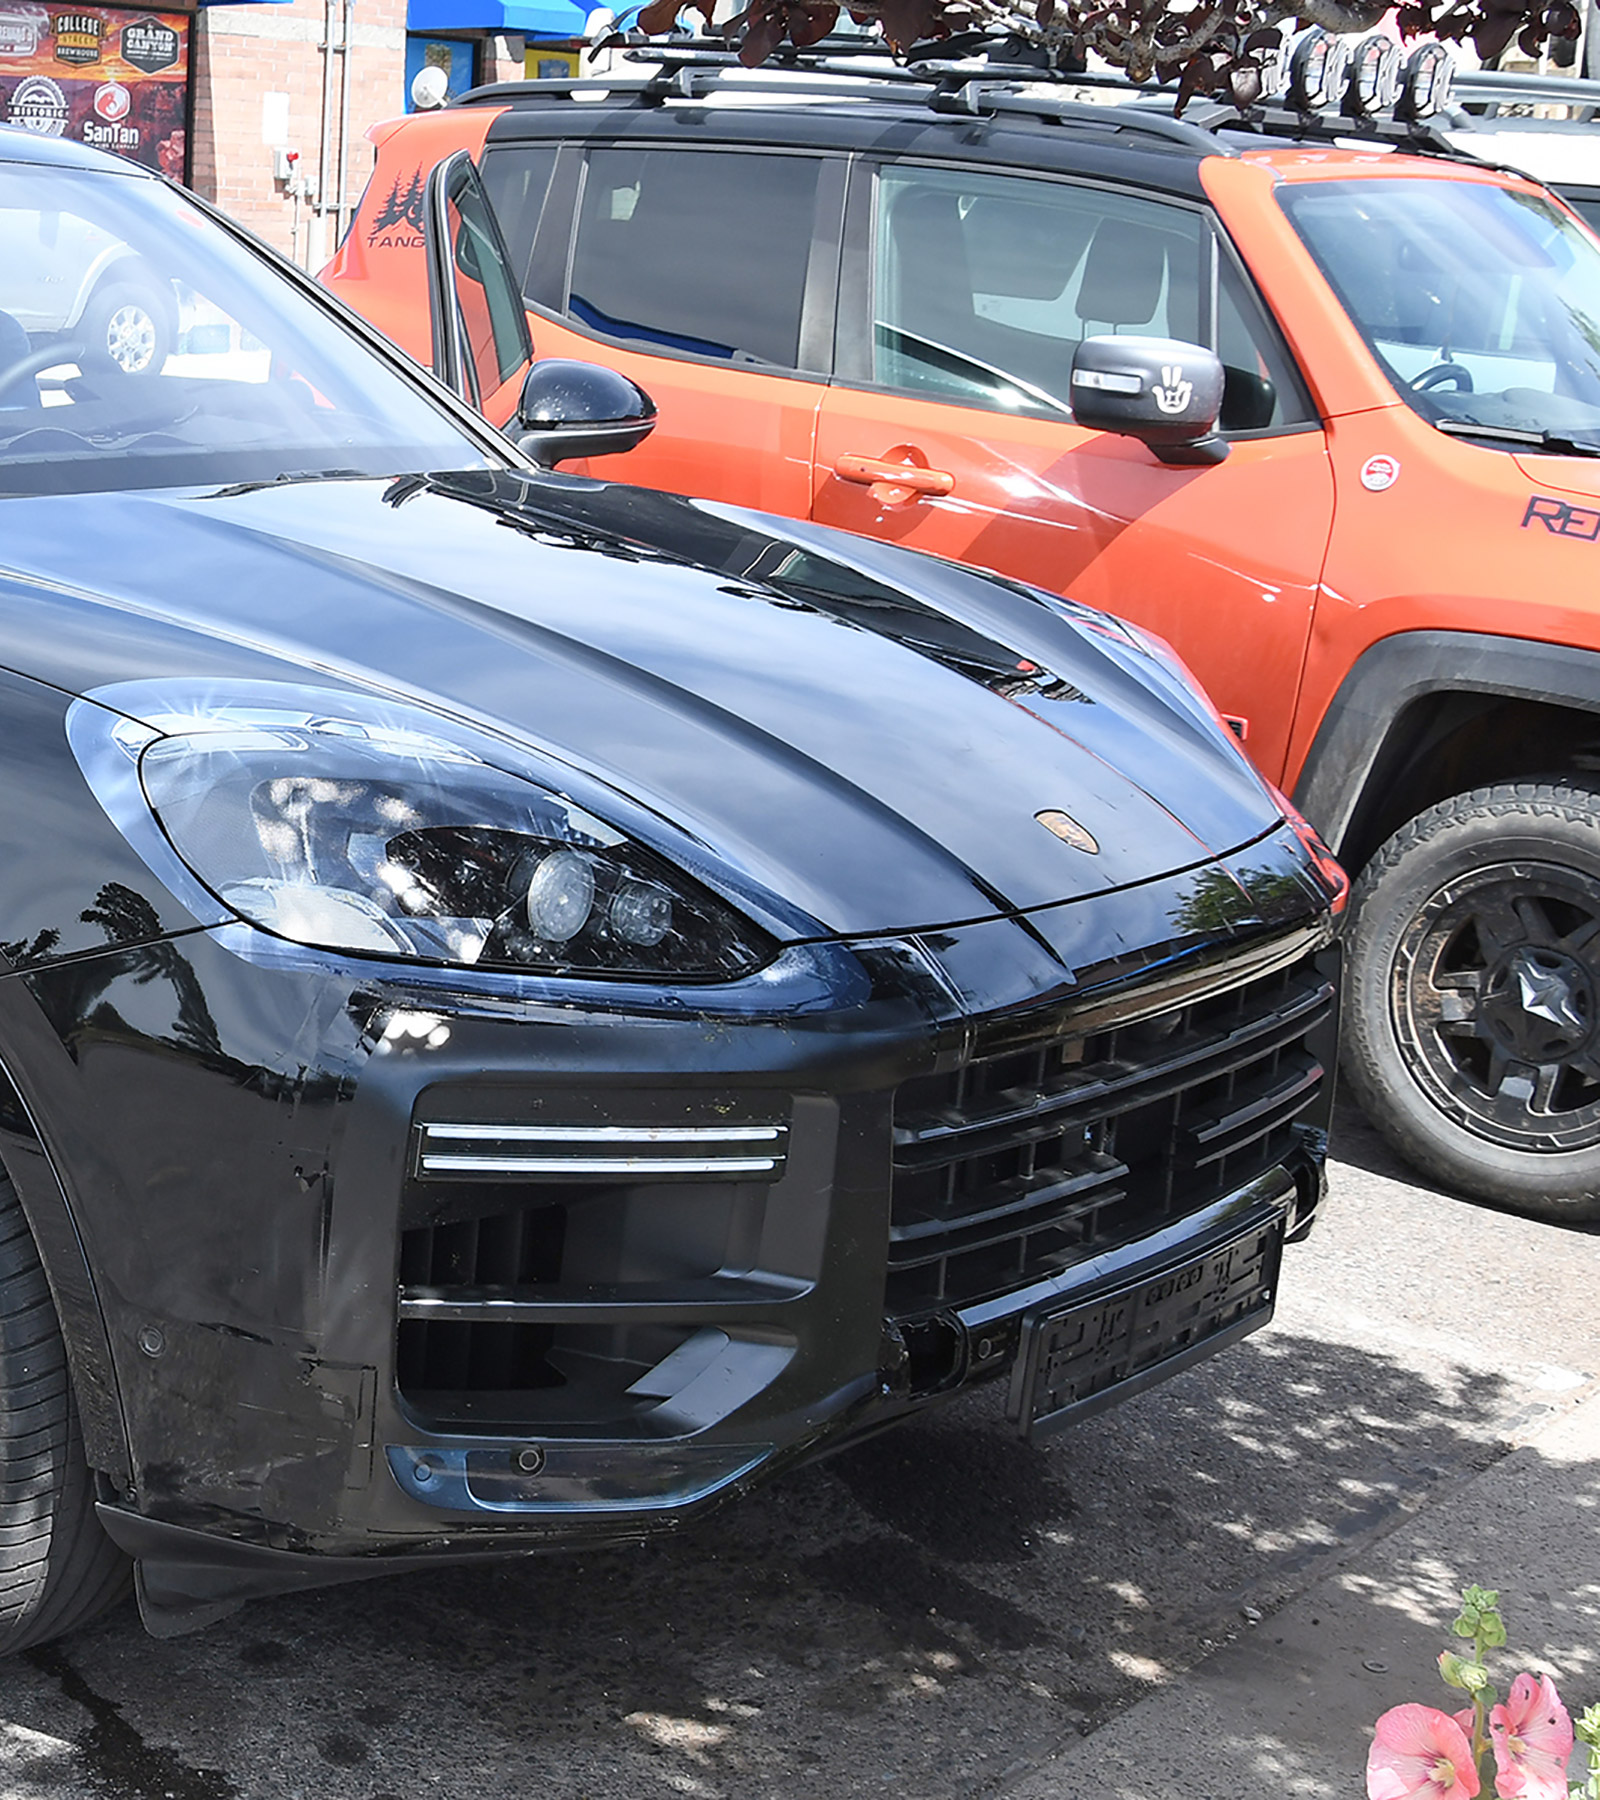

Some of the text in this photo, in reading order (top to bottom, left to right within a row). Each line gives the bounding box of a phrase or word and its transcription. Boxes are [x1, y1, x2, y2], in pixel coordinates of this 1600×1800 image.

[58, 15, 98, 36] COLLEGE
[127, 28, 174, 41] GRAND
[127, 39, 174, 51] CANYON
[57, 47, 98, 57] BREWHOUSE
[13, 106, 64, 118] HISTORIC
[83, 121, 139, 145] SanTan
